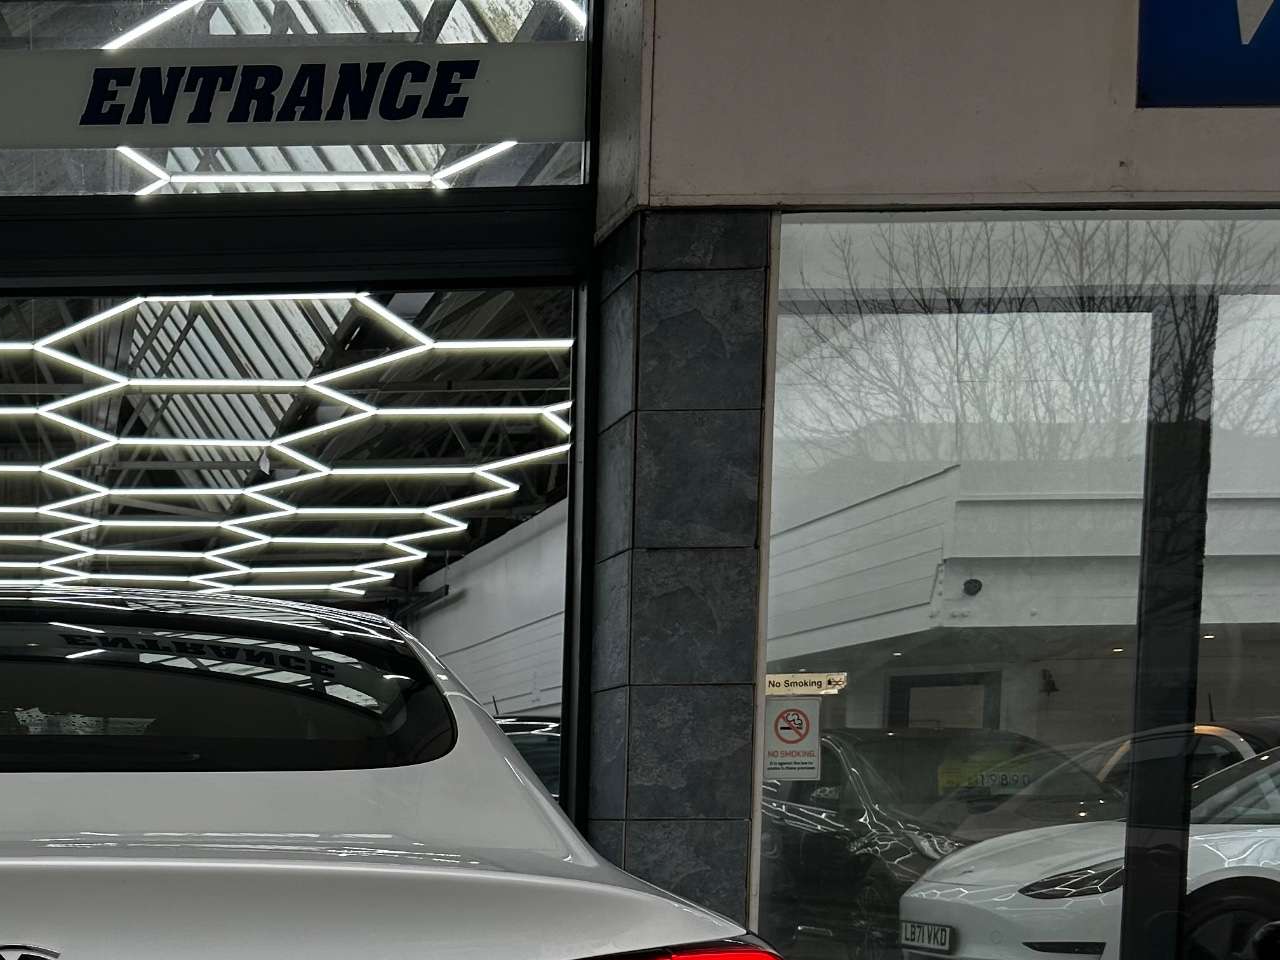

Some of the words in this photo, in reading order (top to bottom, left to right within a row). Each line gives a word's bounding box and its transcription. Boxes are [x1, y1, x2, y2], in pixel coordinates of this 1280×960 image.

[79, 60, 481, 126] ENTRANCE
[768, 680, 781, 688] No
[783, 679, 823, 689] Smoking
